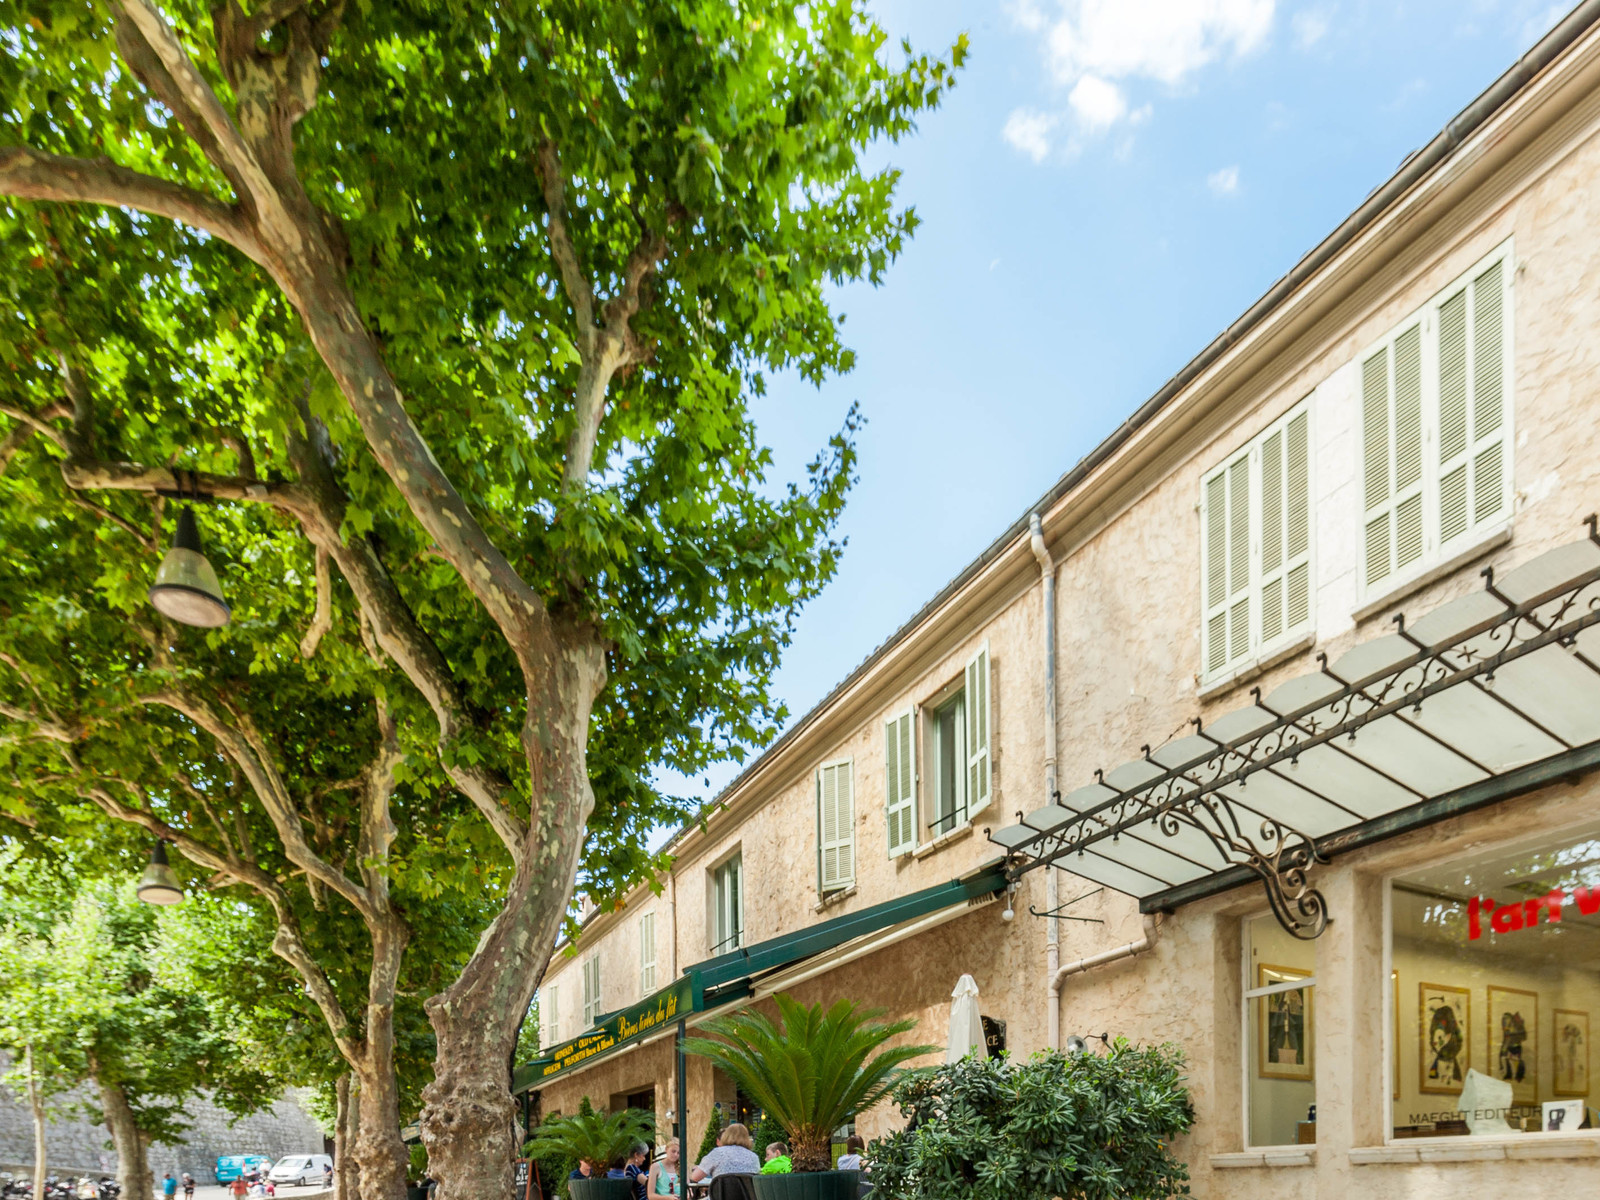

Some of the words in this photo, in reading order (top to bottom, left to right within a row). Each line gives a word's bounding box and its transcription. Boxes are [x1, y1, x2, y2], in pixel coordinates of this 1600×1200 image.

[1467, 887, 1566, 940] l'art
[1573, 884, 1600, 916] v
[986, 1035, 998, 1046] CE
[1409, 1110, 1470, 1124] MAEGHT
[1474, 1105, 1541, 1121] EDITEUR
